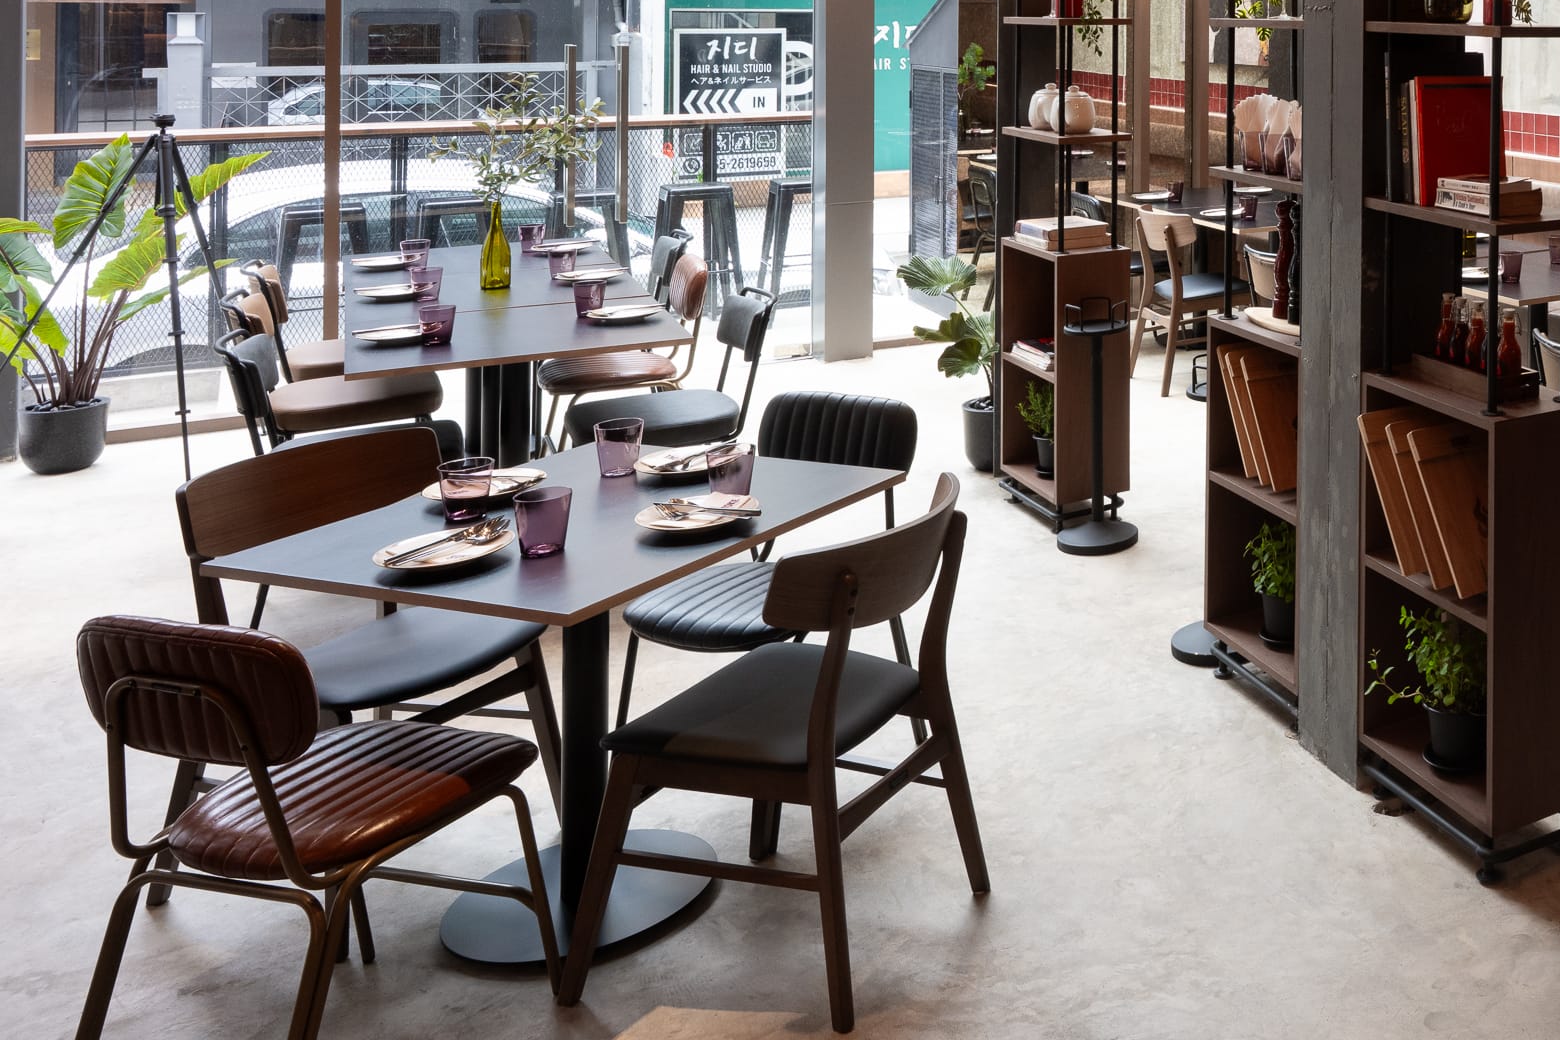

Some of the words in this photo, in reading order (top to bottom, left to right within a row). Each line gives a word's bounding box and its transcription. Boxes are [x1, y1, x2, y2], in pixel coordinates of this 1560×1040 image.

[691, 64, 710, 74] HAIR
[713, 64, 719, 73] &
[722, 64, 741, 73] NAIL
[743, 63, 772, 73] STUDIO
[753, 96, 766, 108] IN
